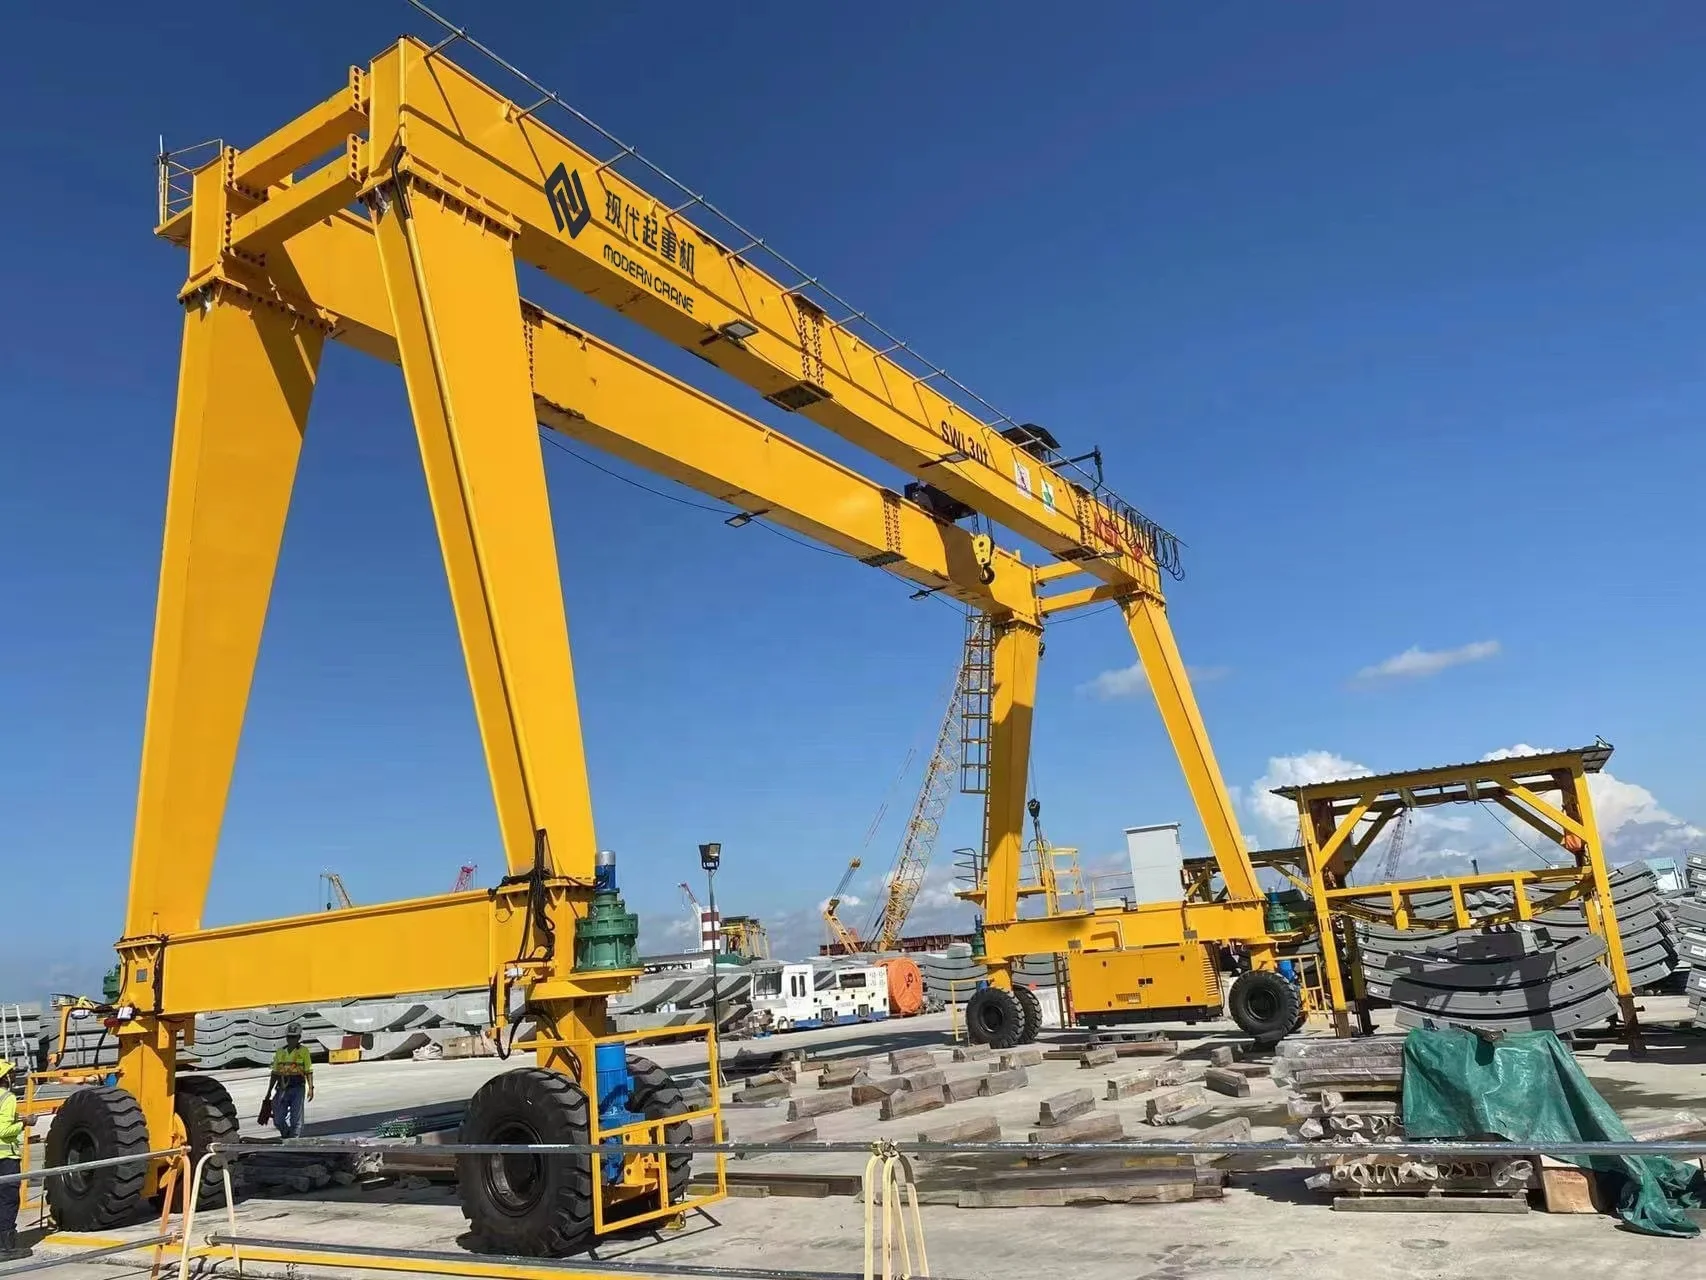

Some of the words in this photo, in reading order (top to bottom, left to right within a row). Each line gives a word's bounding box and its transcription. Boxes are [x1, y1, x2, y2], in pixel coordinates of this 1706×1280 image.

[605, 189, 695, 275] 现代起重机
[603, 244, 652, 288] MODERN
[654, 277, 694, 315] CRANE
